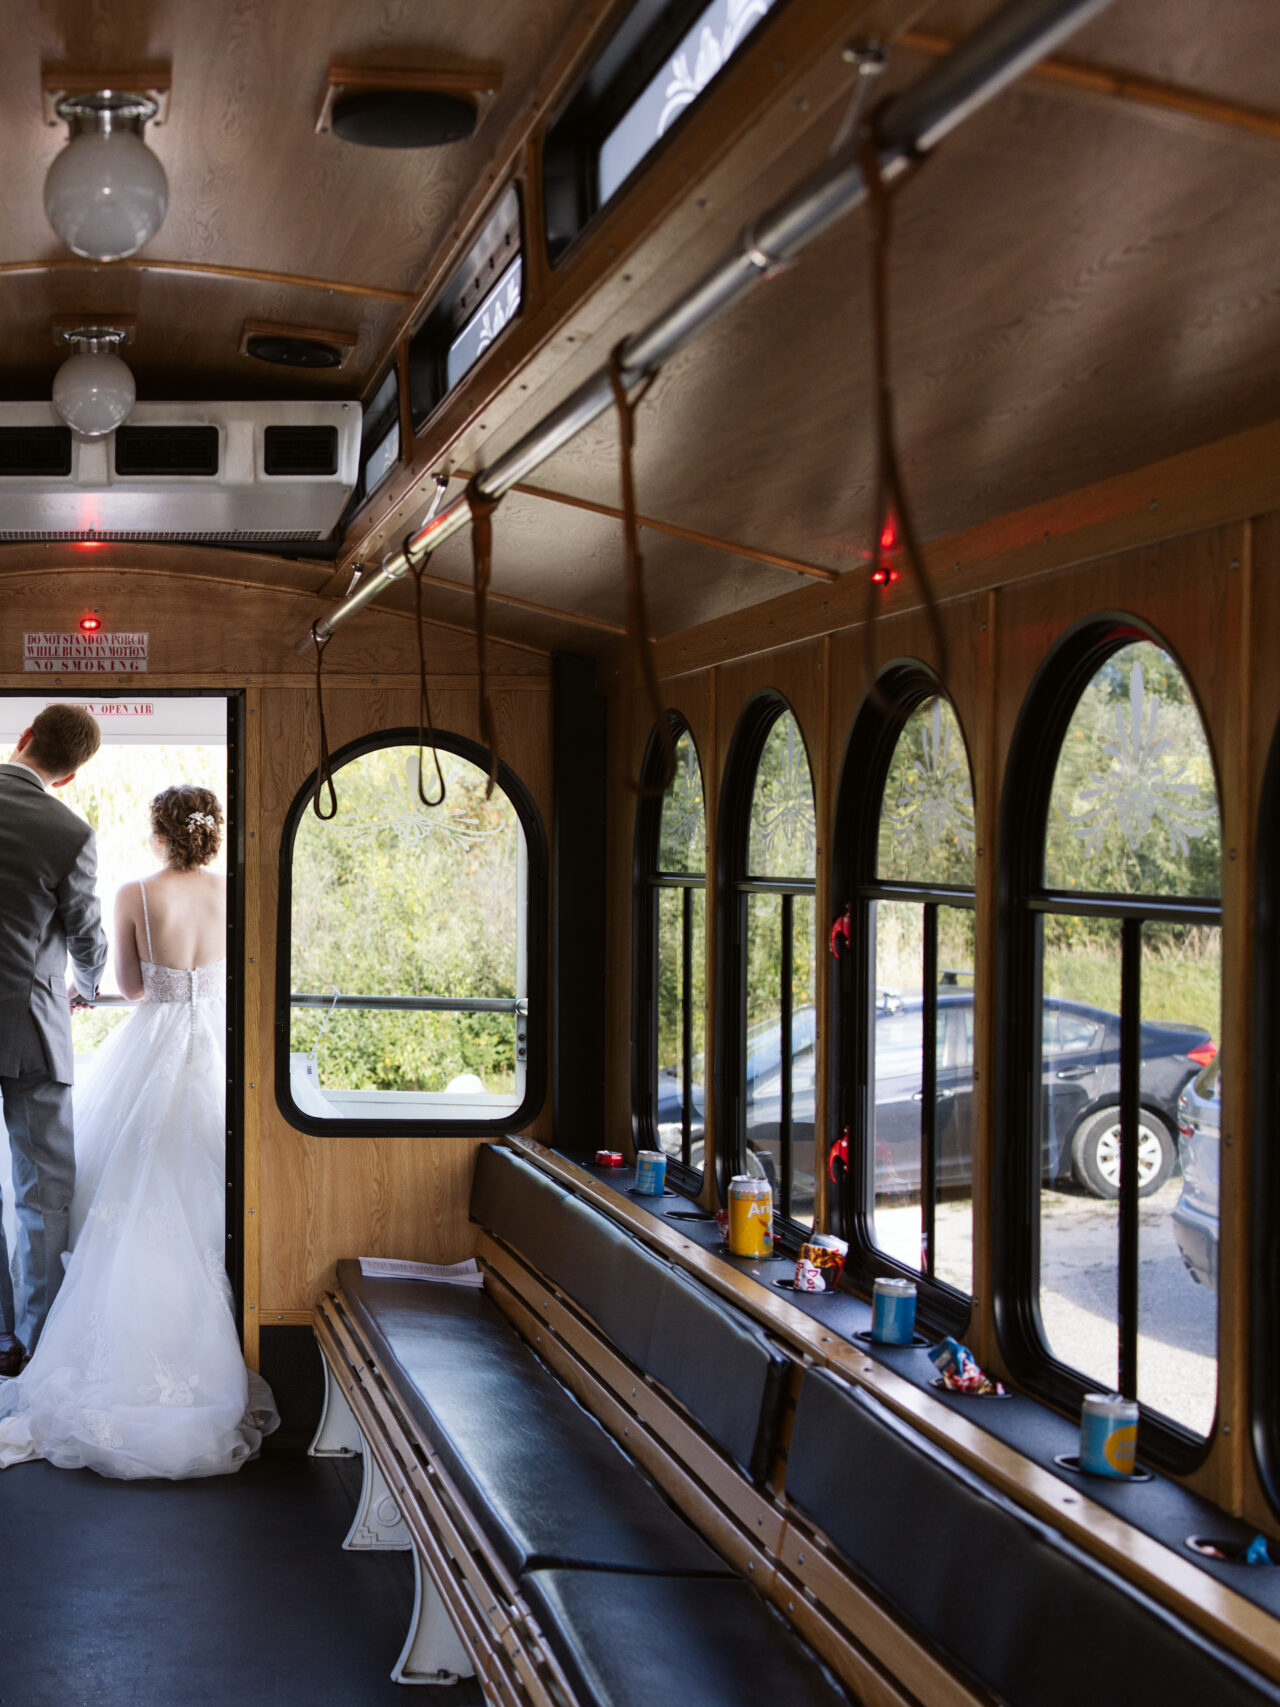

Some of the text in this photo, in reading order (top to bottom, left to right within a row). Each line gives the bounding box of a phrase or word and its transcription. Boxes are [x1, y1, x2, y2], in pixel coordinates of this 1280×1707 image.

[27, 634, 145, 645] DO NOT STAND ON PORCH
[27, 646, 60, 656] WHILE
[62, 646, 81, 656] BUS
[96, 646, 107, 656] IN
[108, 646, 146, 656] MOTION
[34, 660, 140, 671] NO SMOKING
[101, 704, 129, 714] OPEN
[133, 704, 152, 714] AIR
